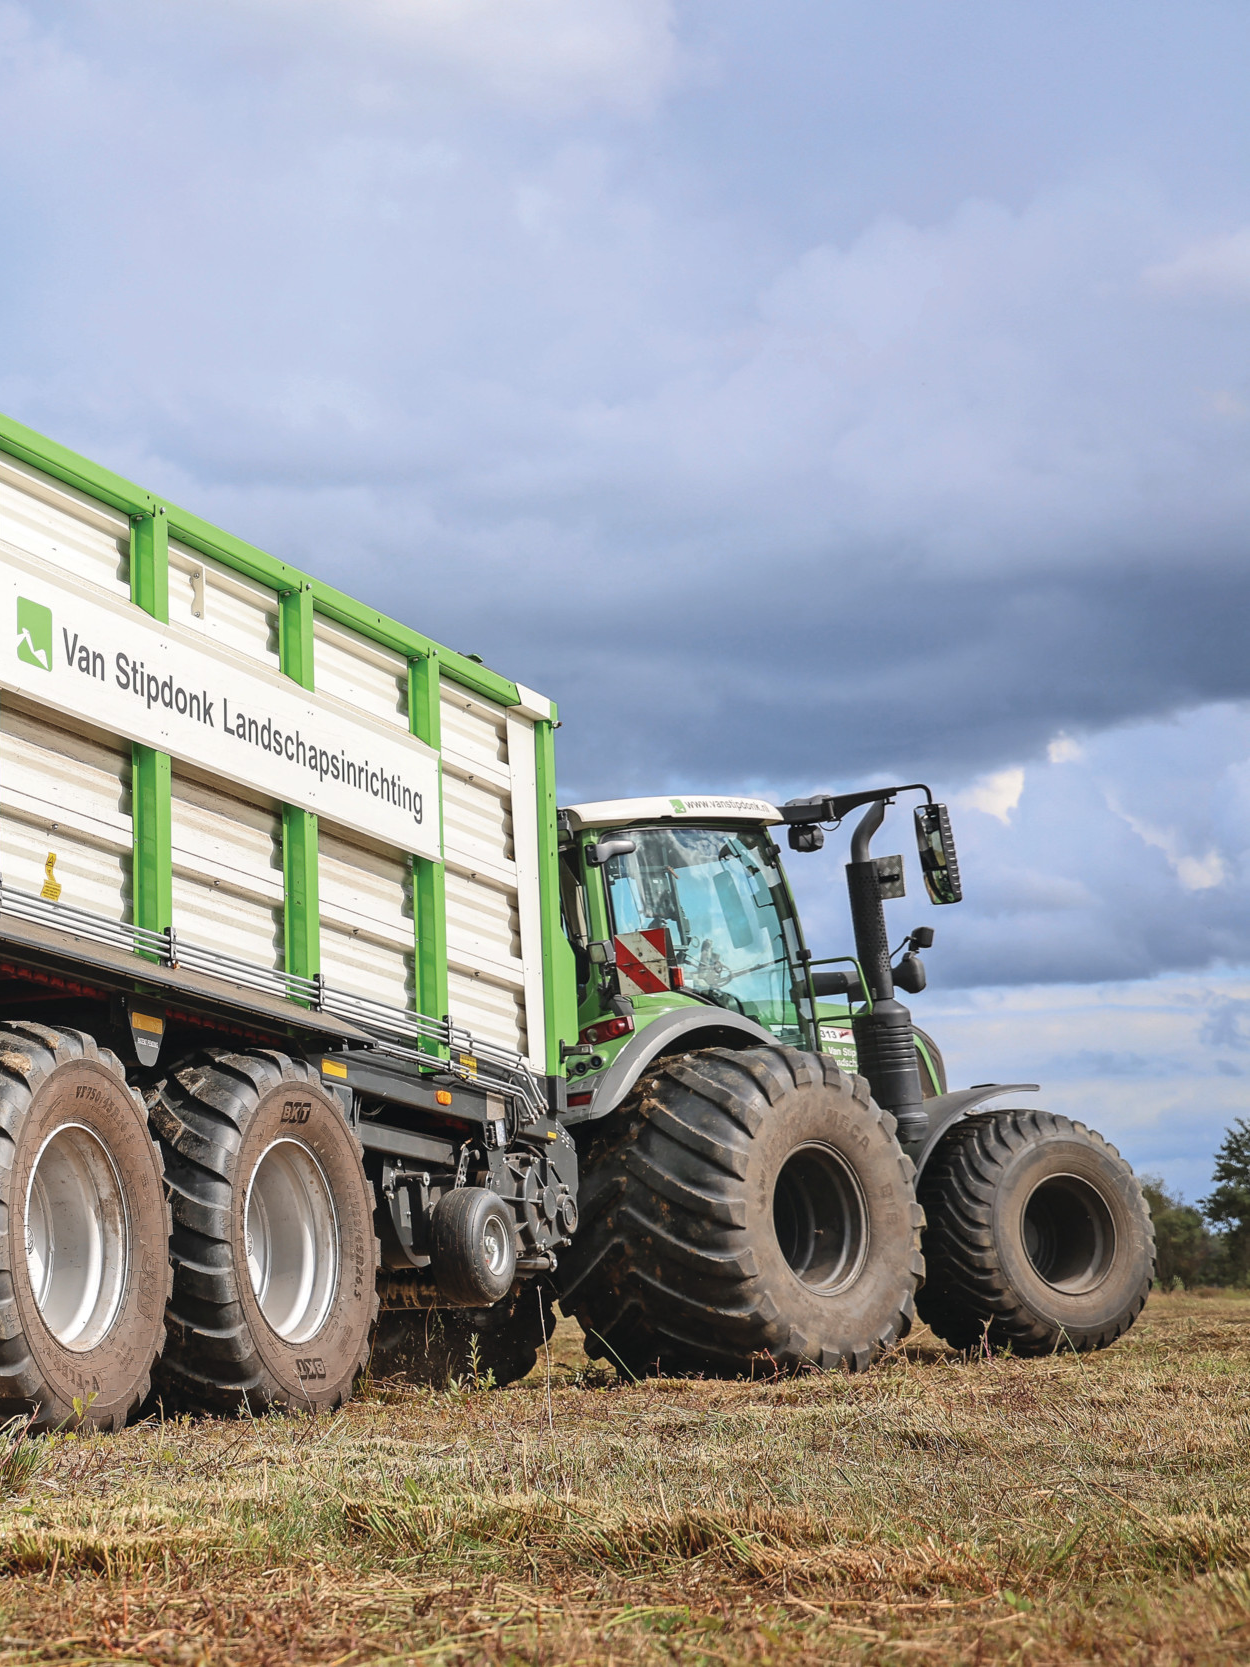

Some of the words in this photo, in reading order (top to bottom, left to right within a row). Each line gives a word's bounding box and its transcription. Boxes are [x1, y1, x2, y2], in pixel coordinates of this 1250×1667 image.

[62, 626, 106, 682] Van
[115, 651, 215, 728] Stipdonk
[223, 697, 424, 825] Landschapsinrichting
[685, 799, 770, 813] www.vanstipdonk.nl
[843, 1047, 857, 1059] Stip
[281, 1101, 312, 1125] BKT
[296, 1357, 327, 1380] BKT
